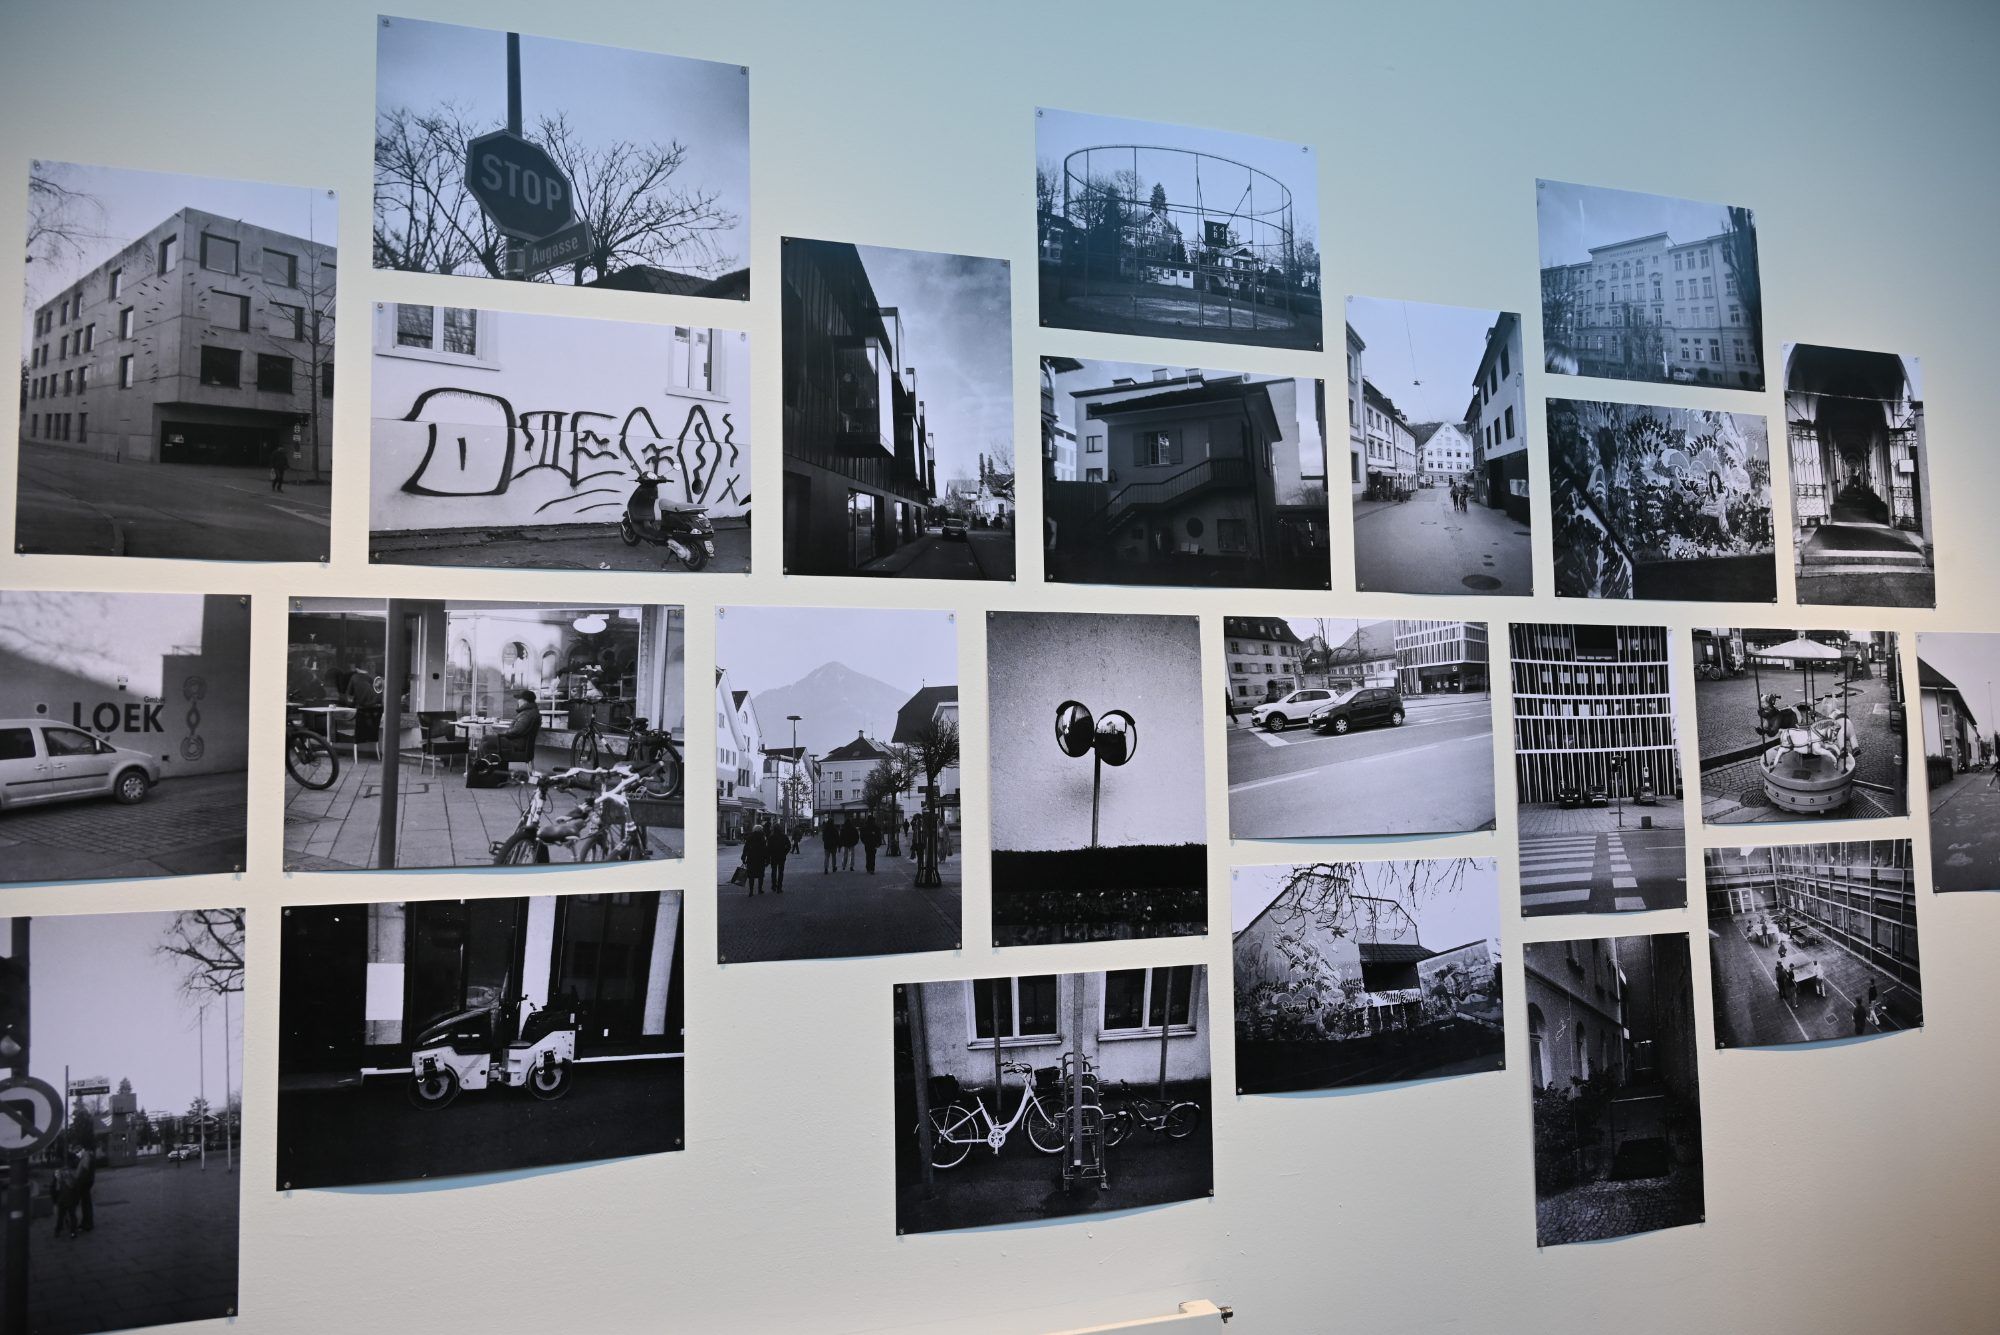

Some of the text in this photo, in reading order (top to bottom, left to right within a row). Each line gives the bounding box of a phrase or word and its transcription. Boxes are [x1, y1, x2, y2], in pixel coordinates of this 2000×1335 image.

[481, 154, 562, 210] STOP
[532, 236, 579, 265] Augasse
[73, 702, 165, 733] LOEK
